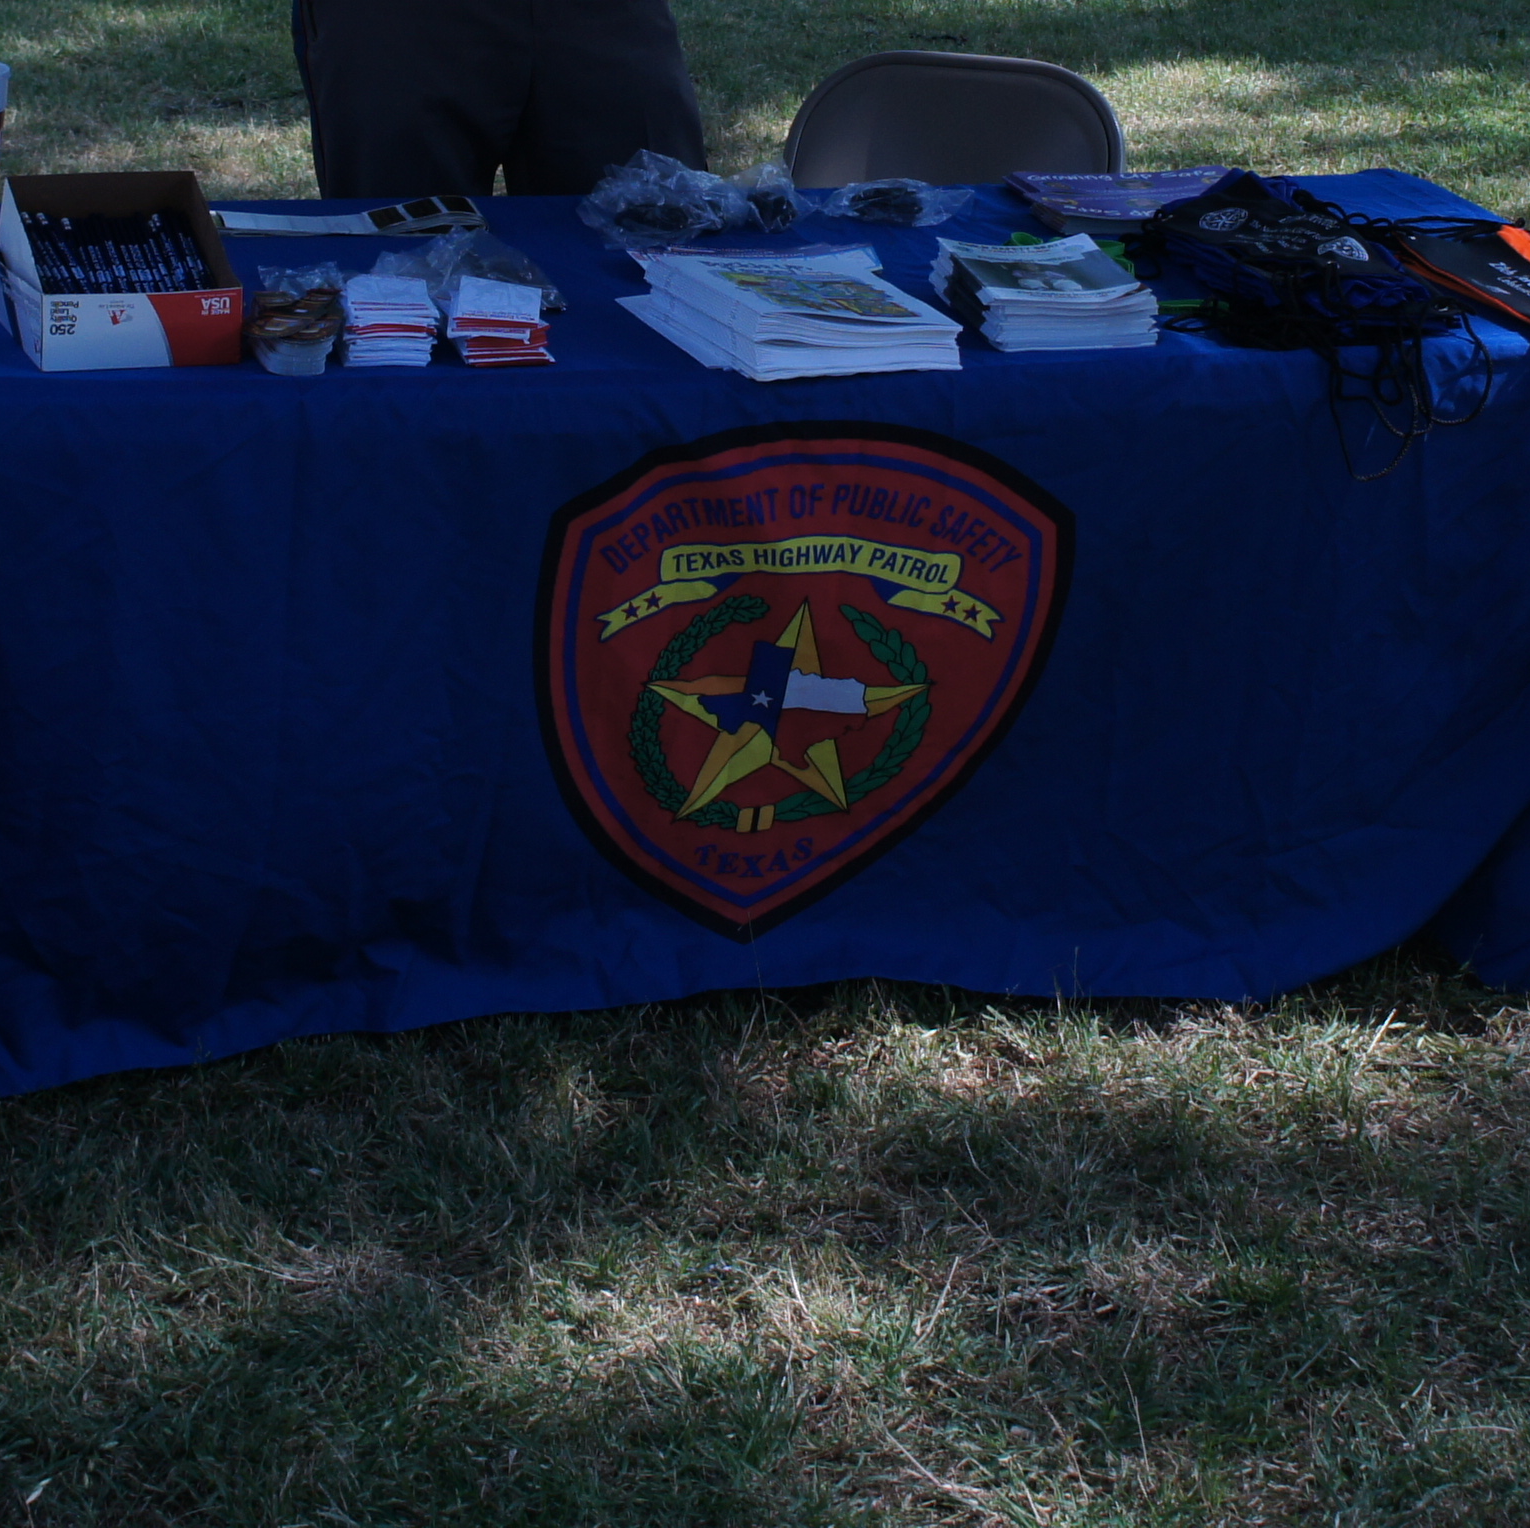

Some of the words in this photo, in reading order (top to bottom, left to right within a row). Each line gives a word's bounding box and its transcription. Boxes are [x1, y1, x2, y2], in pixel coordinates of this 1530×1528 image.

[49, 300, 80, 309] Pencils
[200, 296, 231, 310] USA
[49, 313, 78, 323] Quality
[49, 323, 76, 336] 250
[599, 488, 779, 575] DEPARTMENT
[789, 482, 824, 517] OF
[831, 482, 932, 530] PUBLIC
[930, 504, 1025, 575] SAFETY
[672, 548, 746, 575] TEXAS
[752, 542, 865, 569] HIGHWAY
[867, 550, 950, 586] PATROL
[693, 836, 816, 879] TEXAS
